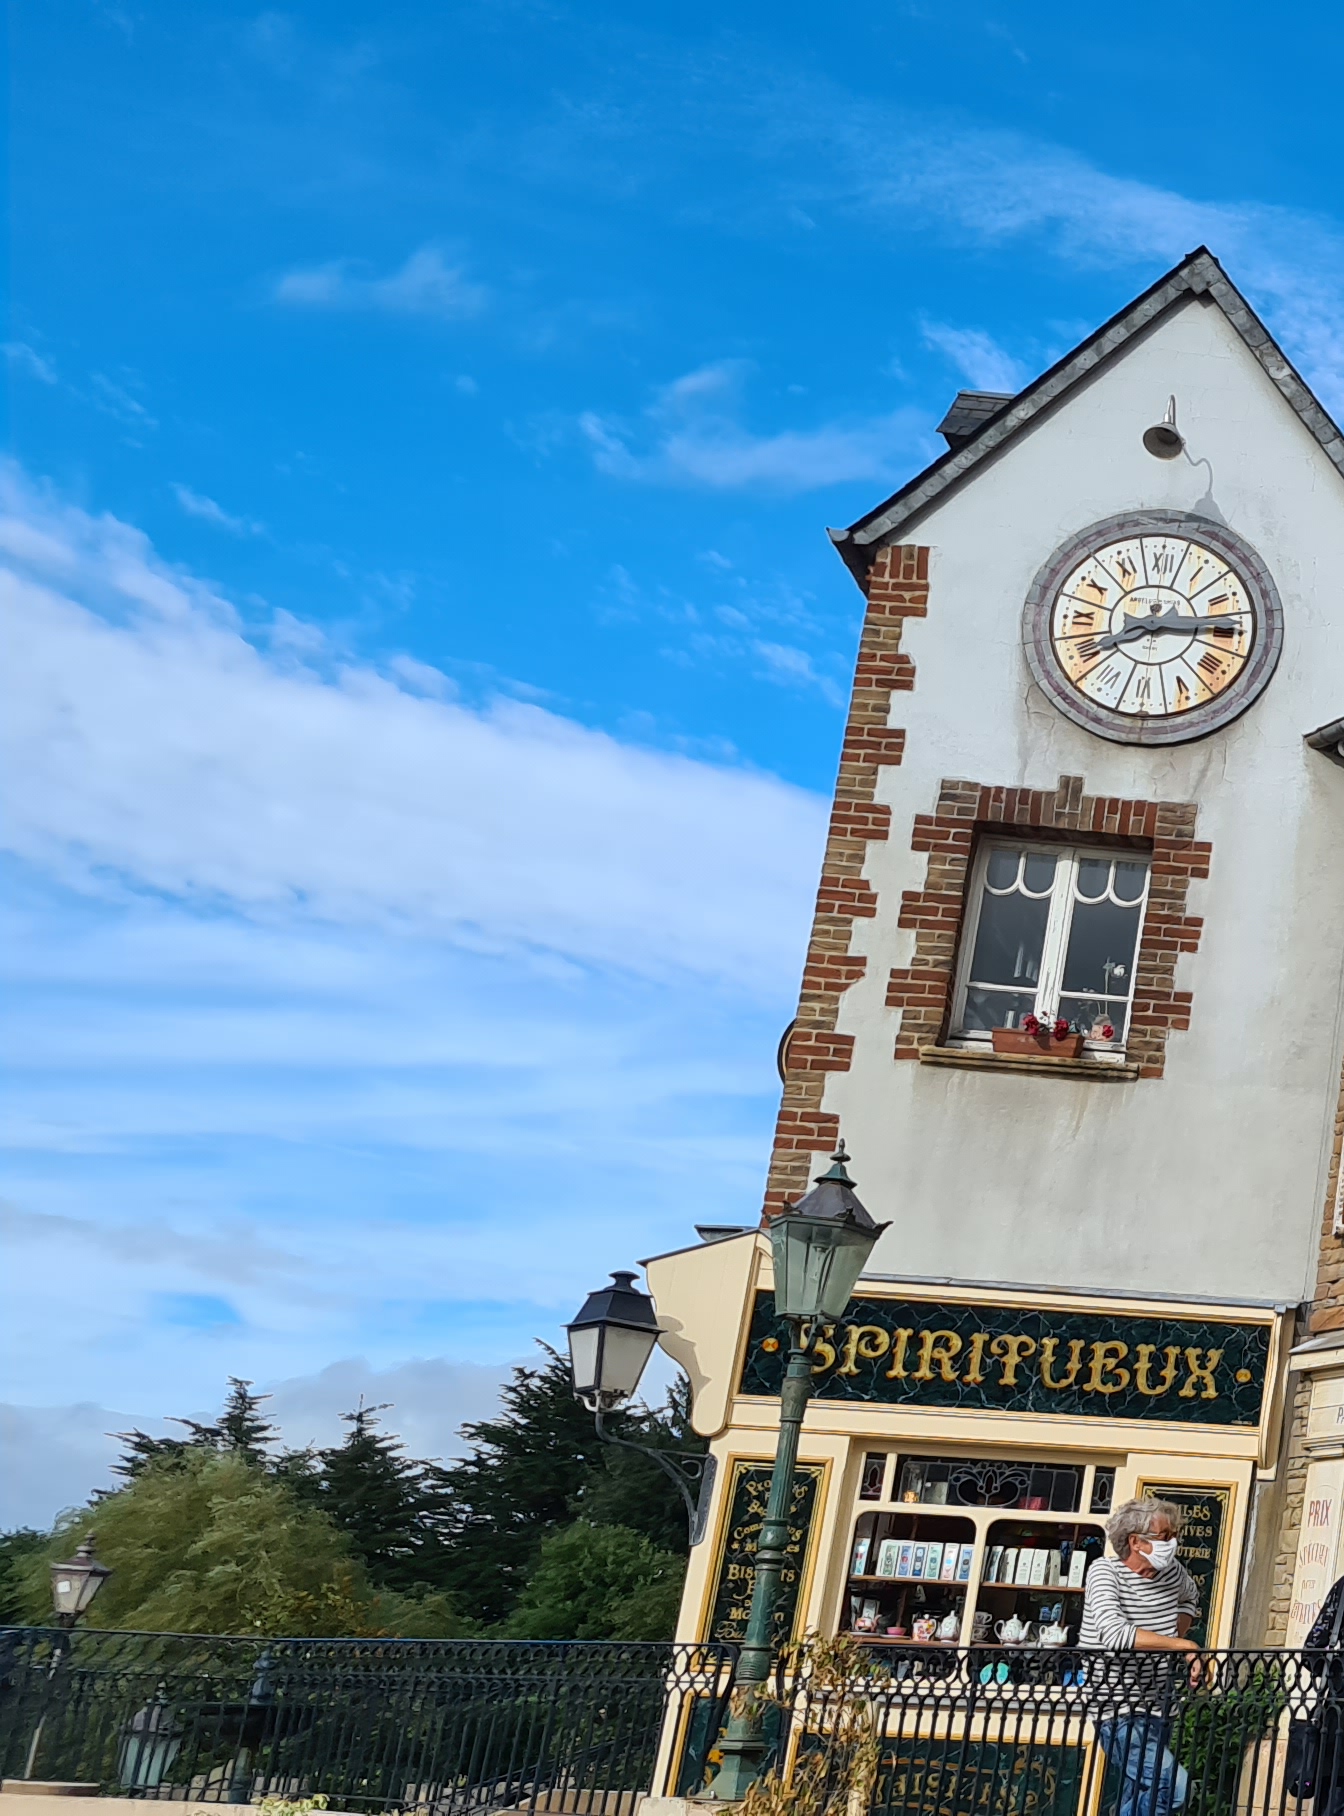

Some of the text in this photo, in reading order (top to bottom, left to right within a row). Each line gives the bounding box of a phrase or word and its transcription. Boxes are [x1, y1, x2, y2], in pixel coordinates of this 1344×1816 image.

[1115, 556, 1137, 579] XI
[1152, 552, 1174, 575] XII
[1086, 578, 1108, 595] X
[1208, 593, 1230, 607] II
[1072, 609, 1095, 626] IX
[1096, 664, 1121, 690] VII
[801, 1323, 1223, 1399] SPIRITUEUX
[1178, 1504, 1212, 1521] ILES
[1308, 1499, 1332, 1528] PRIX
[1177, 1525, 1213, 1538] LIVES
[1176, 1547, 1212, 1560] UTERIE
